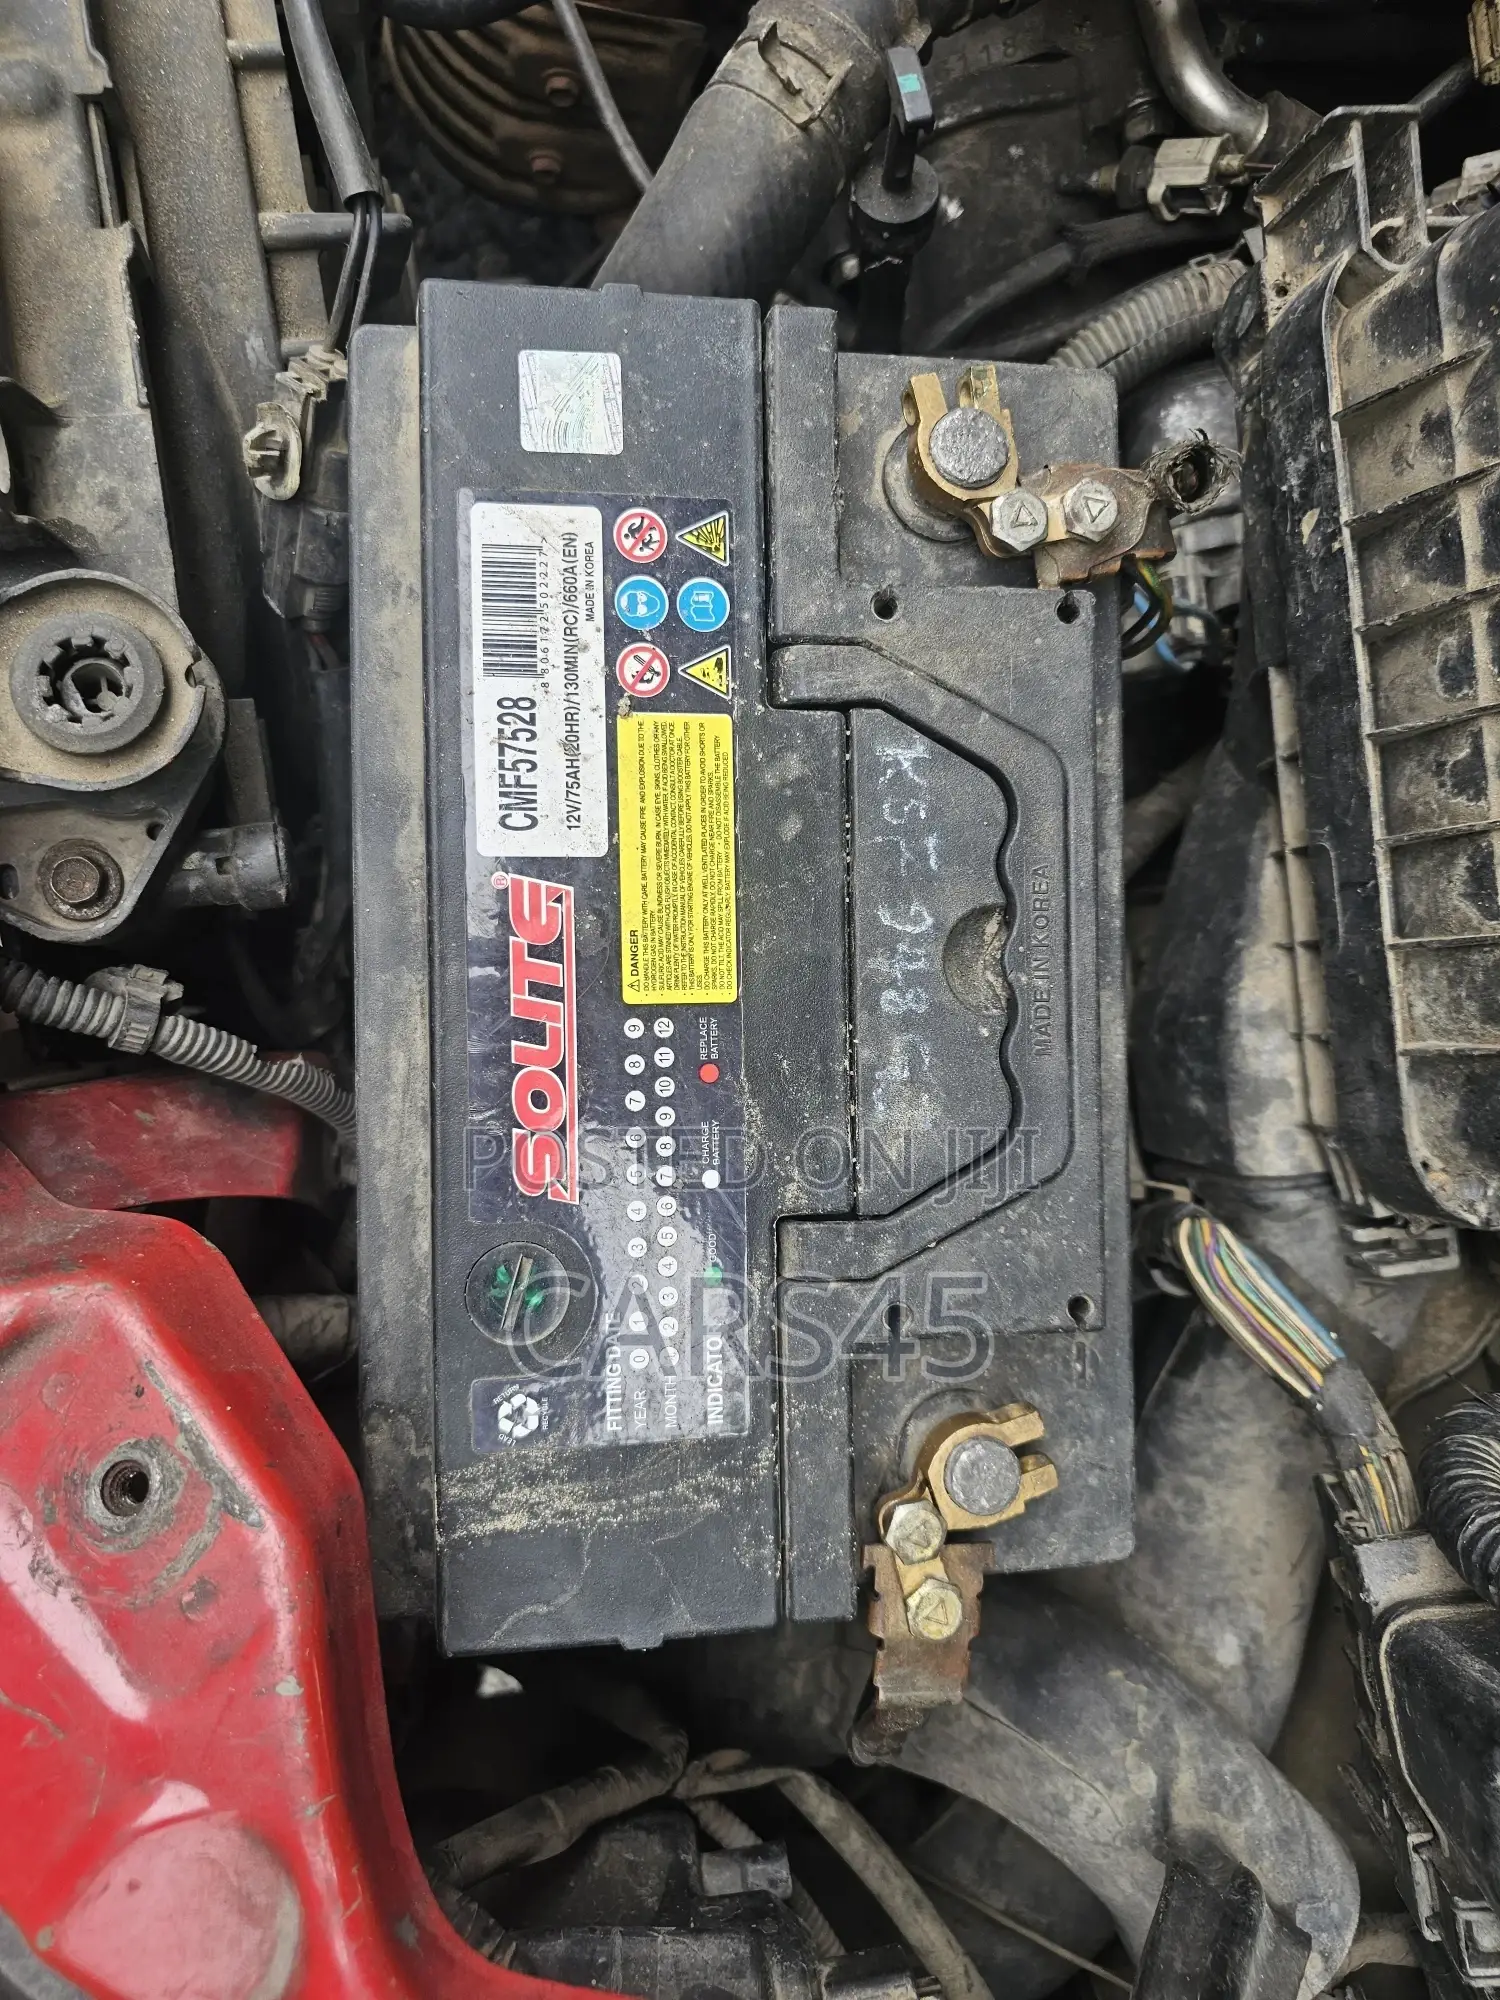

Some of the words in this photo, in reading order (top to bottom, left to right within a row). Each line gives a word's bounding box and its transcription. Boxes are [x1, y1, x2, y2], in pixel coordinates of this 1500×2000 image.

[584, 541, 594, 577] KOREA
[585, 593, 595, 622] MADE
[496, 696, 539, 832] CMF57528
[1030, 863, 1050, 948] KOREA
[630, 929, 640, 977] DANGER
[1031, 956, 1052, 981] IN
[510, 873, 577, 1203] SOLITE
[699, 1016, 709, 1061] REPLACE
[710, 1017, 719, 1060] BATTERY
[1031, 989, 1053, 1057] MADE
[701, 1121, 710, 1164] CHARGE
[711, 1119, 720, 1165] BATTERY
[708, 1233, 717, 1262] GOOD
[604, 1311, 621, 1358] DATE
[492, 1384, 520, 1405] RETURN
[541, 1397, 549, 1430] RECYCLE
[606, 1363, 623, 1432] FITTING
[634, 1389, 647, 1429] YEAR
[664, 1375, 678, 1428] MONTH
[498, 1433, 517, 1447] LEAD
